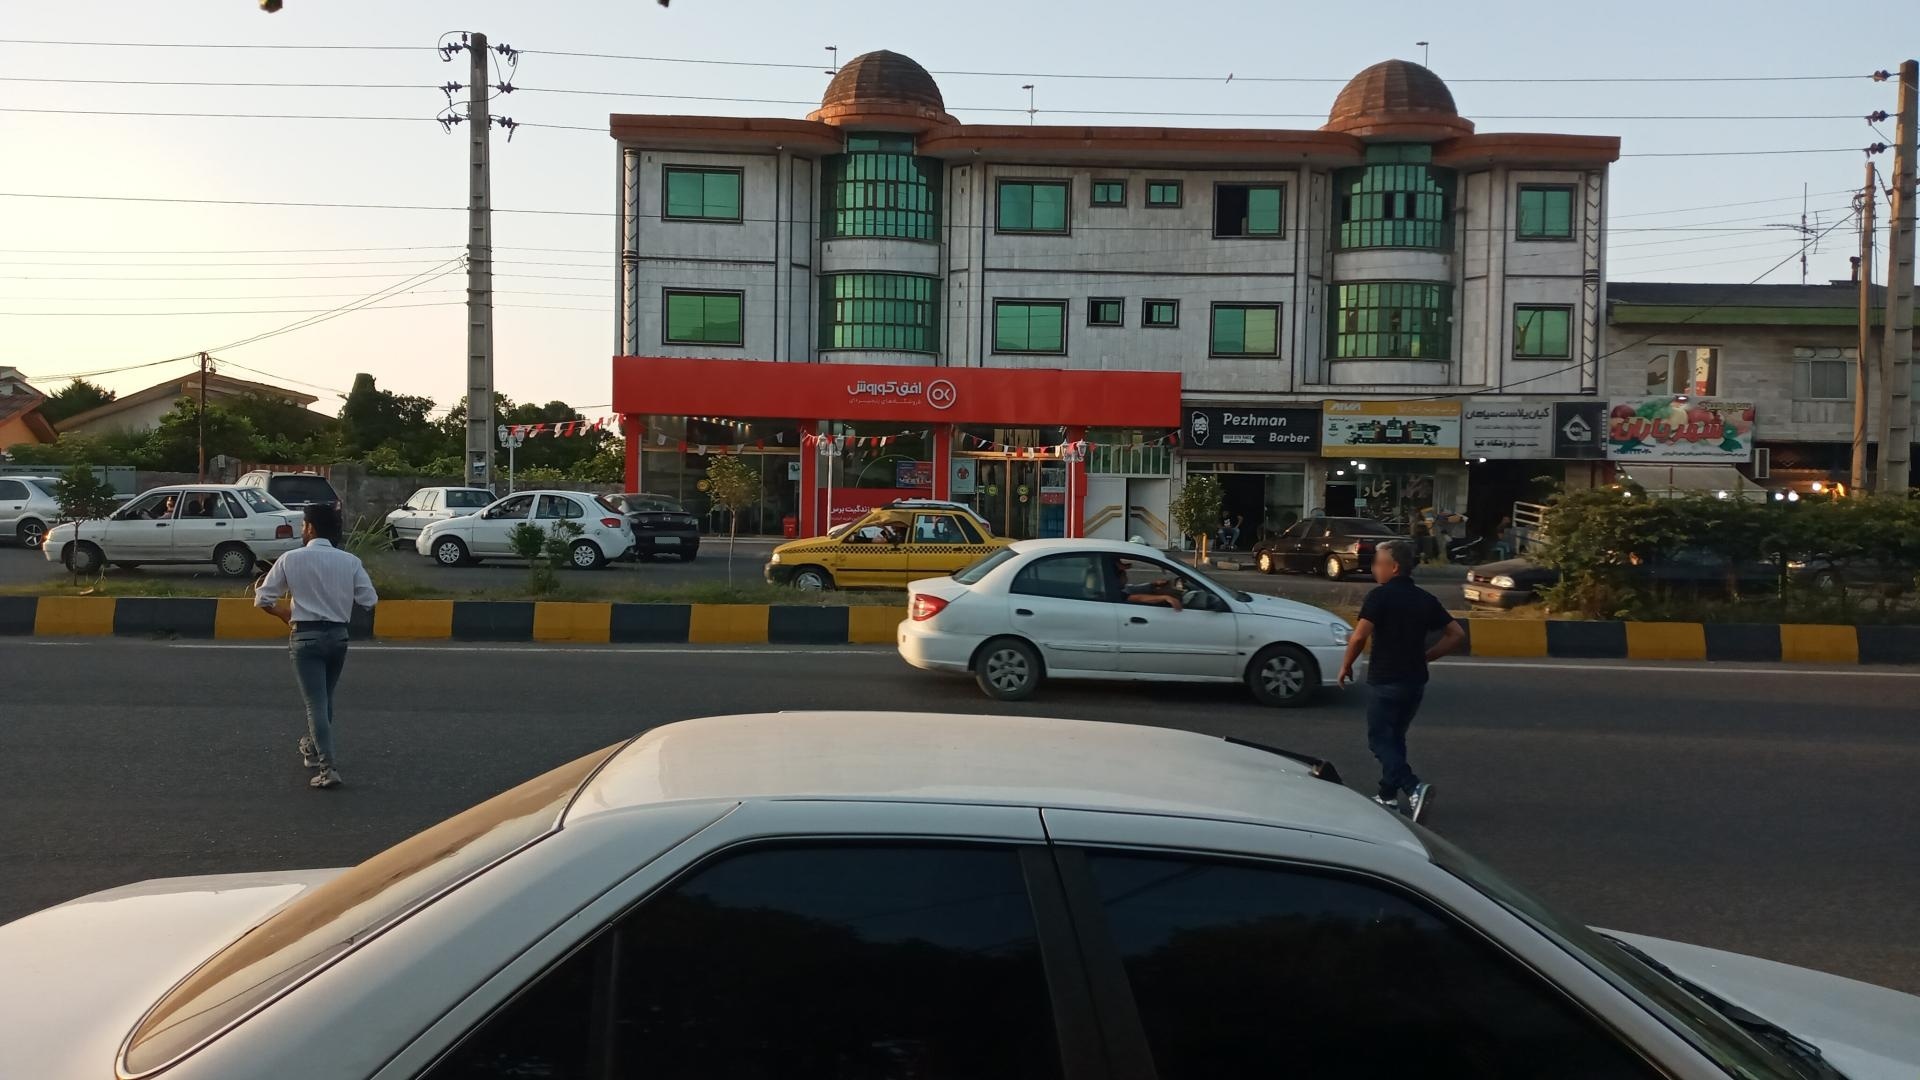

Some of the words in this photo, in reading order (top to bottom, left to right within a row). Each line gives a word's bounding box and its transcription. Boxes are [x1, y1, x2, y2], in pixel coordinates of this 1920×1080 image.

[847, 381, 897, 396] کوروش
[896, 382, 922, 396] افق
[1223, 413, 1287, 427] Pezhman
[1529, 407, 1550, 419] کیان
[1667, 413, 1724, 443] شهر
[1269, 432, 1310, 443] Barber
[1363, 479, 1392, 498] عماد
